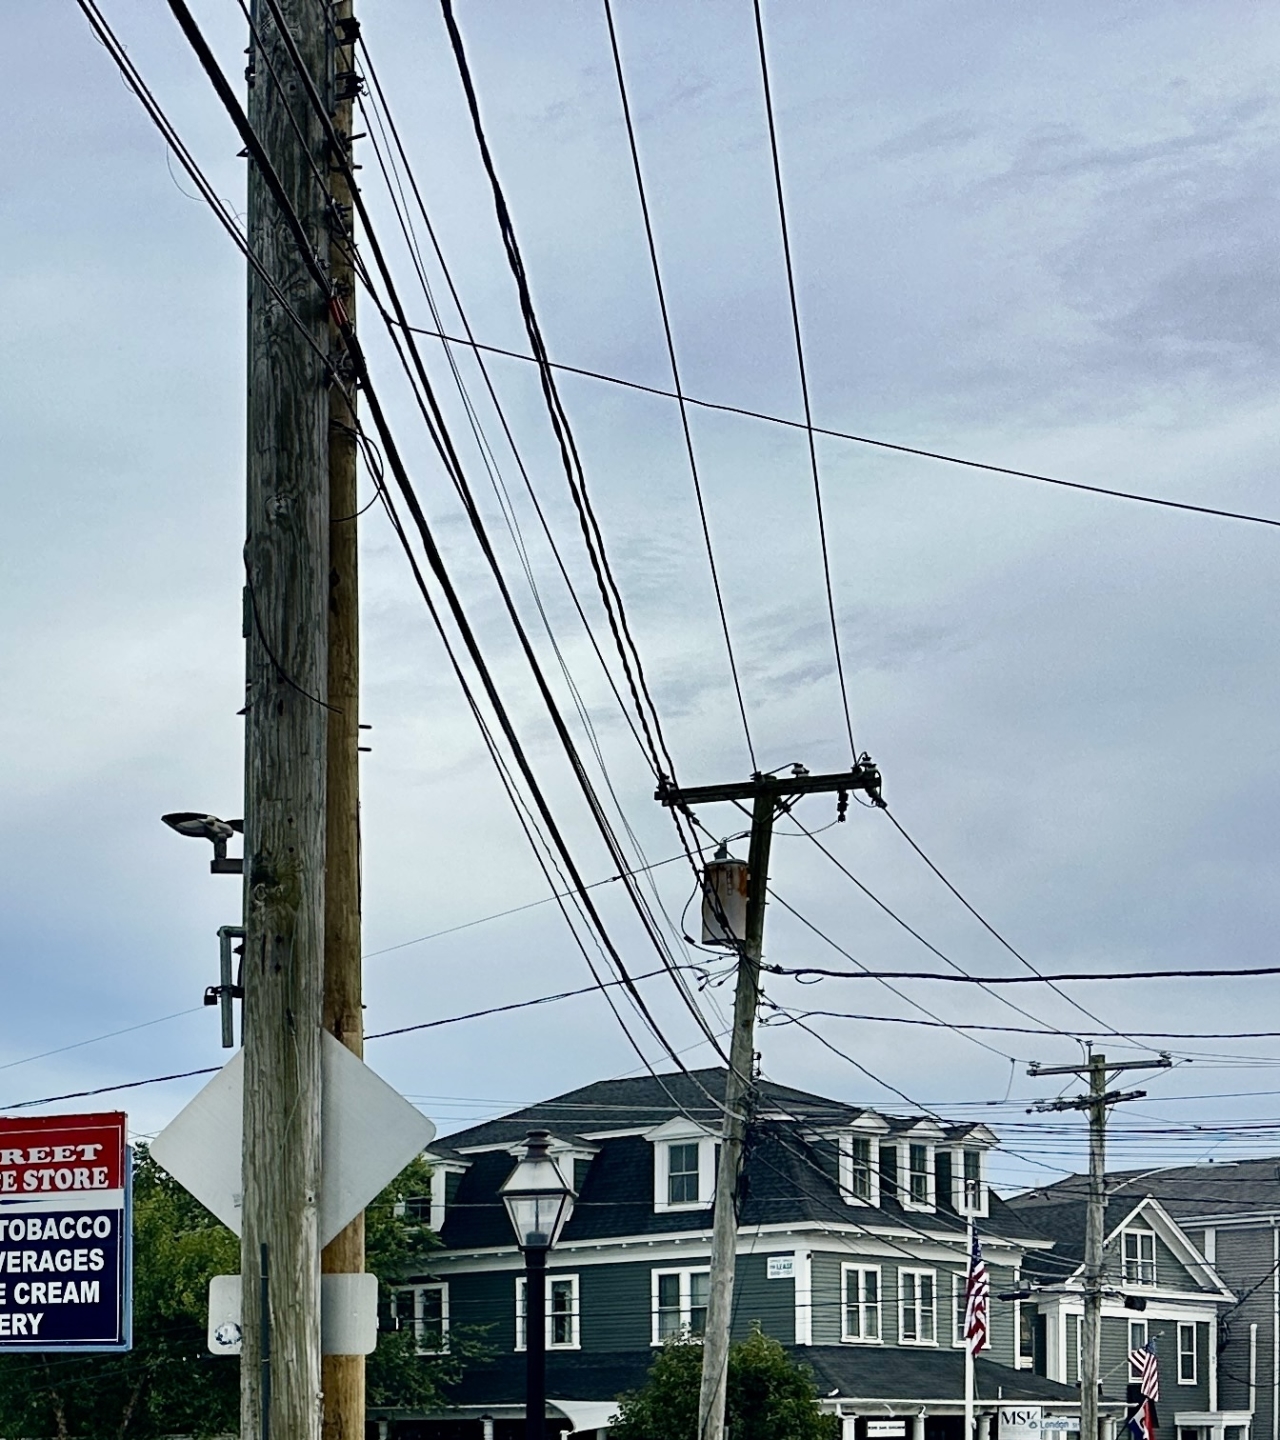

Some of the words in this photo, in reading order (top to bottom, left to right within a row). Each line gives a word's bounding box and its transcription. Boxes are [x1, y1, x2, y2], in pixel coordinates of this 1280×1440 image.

[23, 1166, 110, 1191] STORE
[13, 1281, 100, 1304] CREAM
[1040, 1420, 1069, 1430] London
